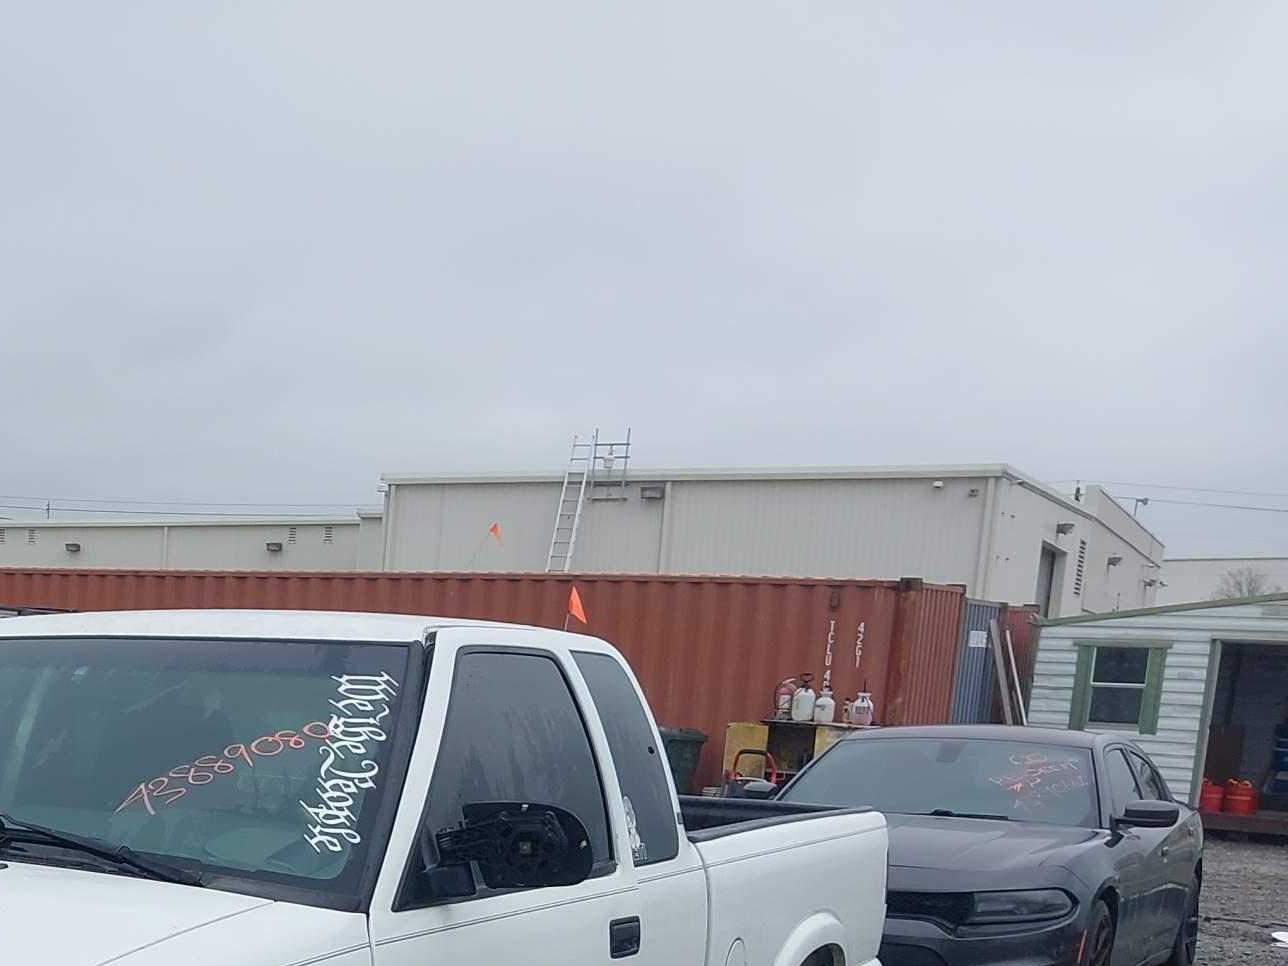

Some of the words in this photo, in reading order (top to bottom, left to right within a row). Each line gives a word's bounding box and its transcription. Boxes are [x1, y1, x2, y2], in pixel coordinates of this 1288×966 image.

[825, 620, 836, 666] TCLU
[328, 671, 399, 716] We
[113, 721, 333, 816] 43889080
[299, 746, 379, 853] People
